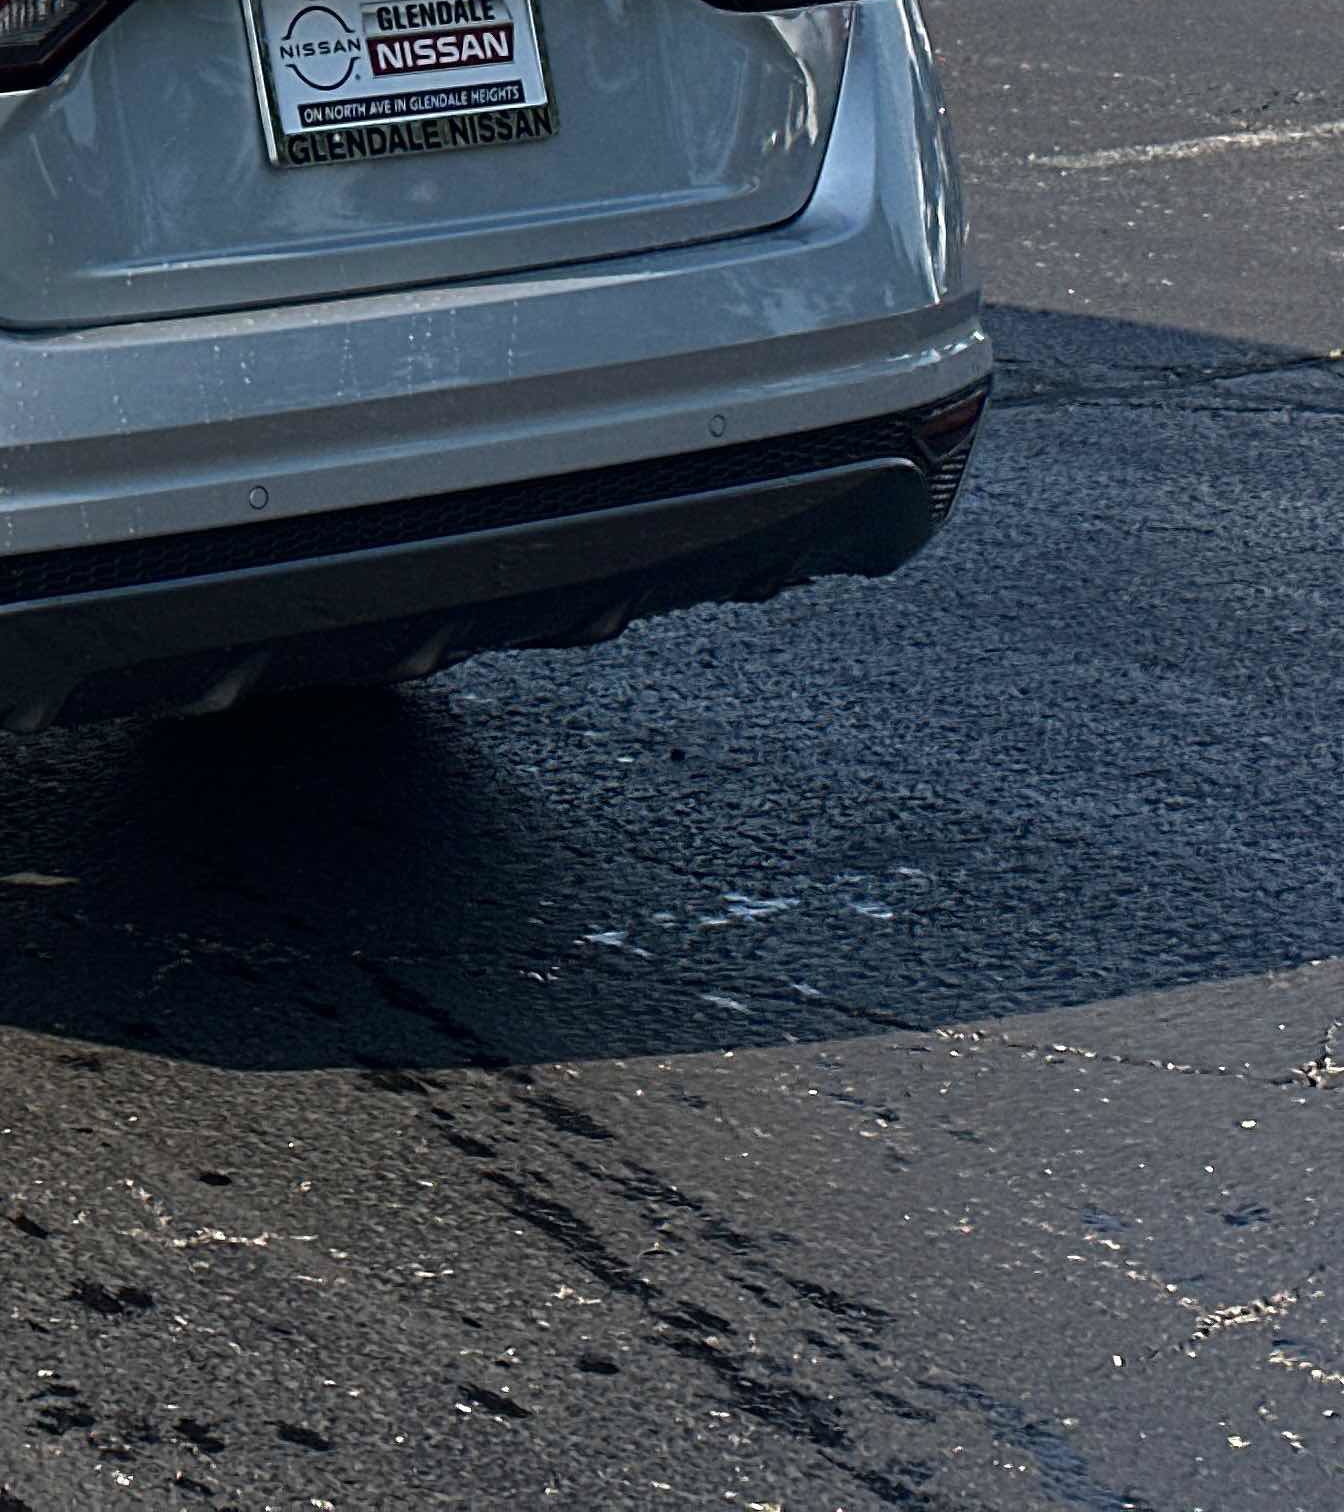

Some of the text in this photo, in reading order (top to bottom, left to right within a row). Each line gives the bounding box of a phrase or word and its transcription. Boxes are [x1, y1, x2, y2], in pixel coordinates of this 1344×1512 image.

[280, 38, 361, 59] NISSAN
[376, 30, 510, 70] NISSAN
[304, 85, 520, 123] ON NORTH AVE IN GLENDALE HEIGHTS
[288, 107, 553, 164] GLENDALE NISSAN
